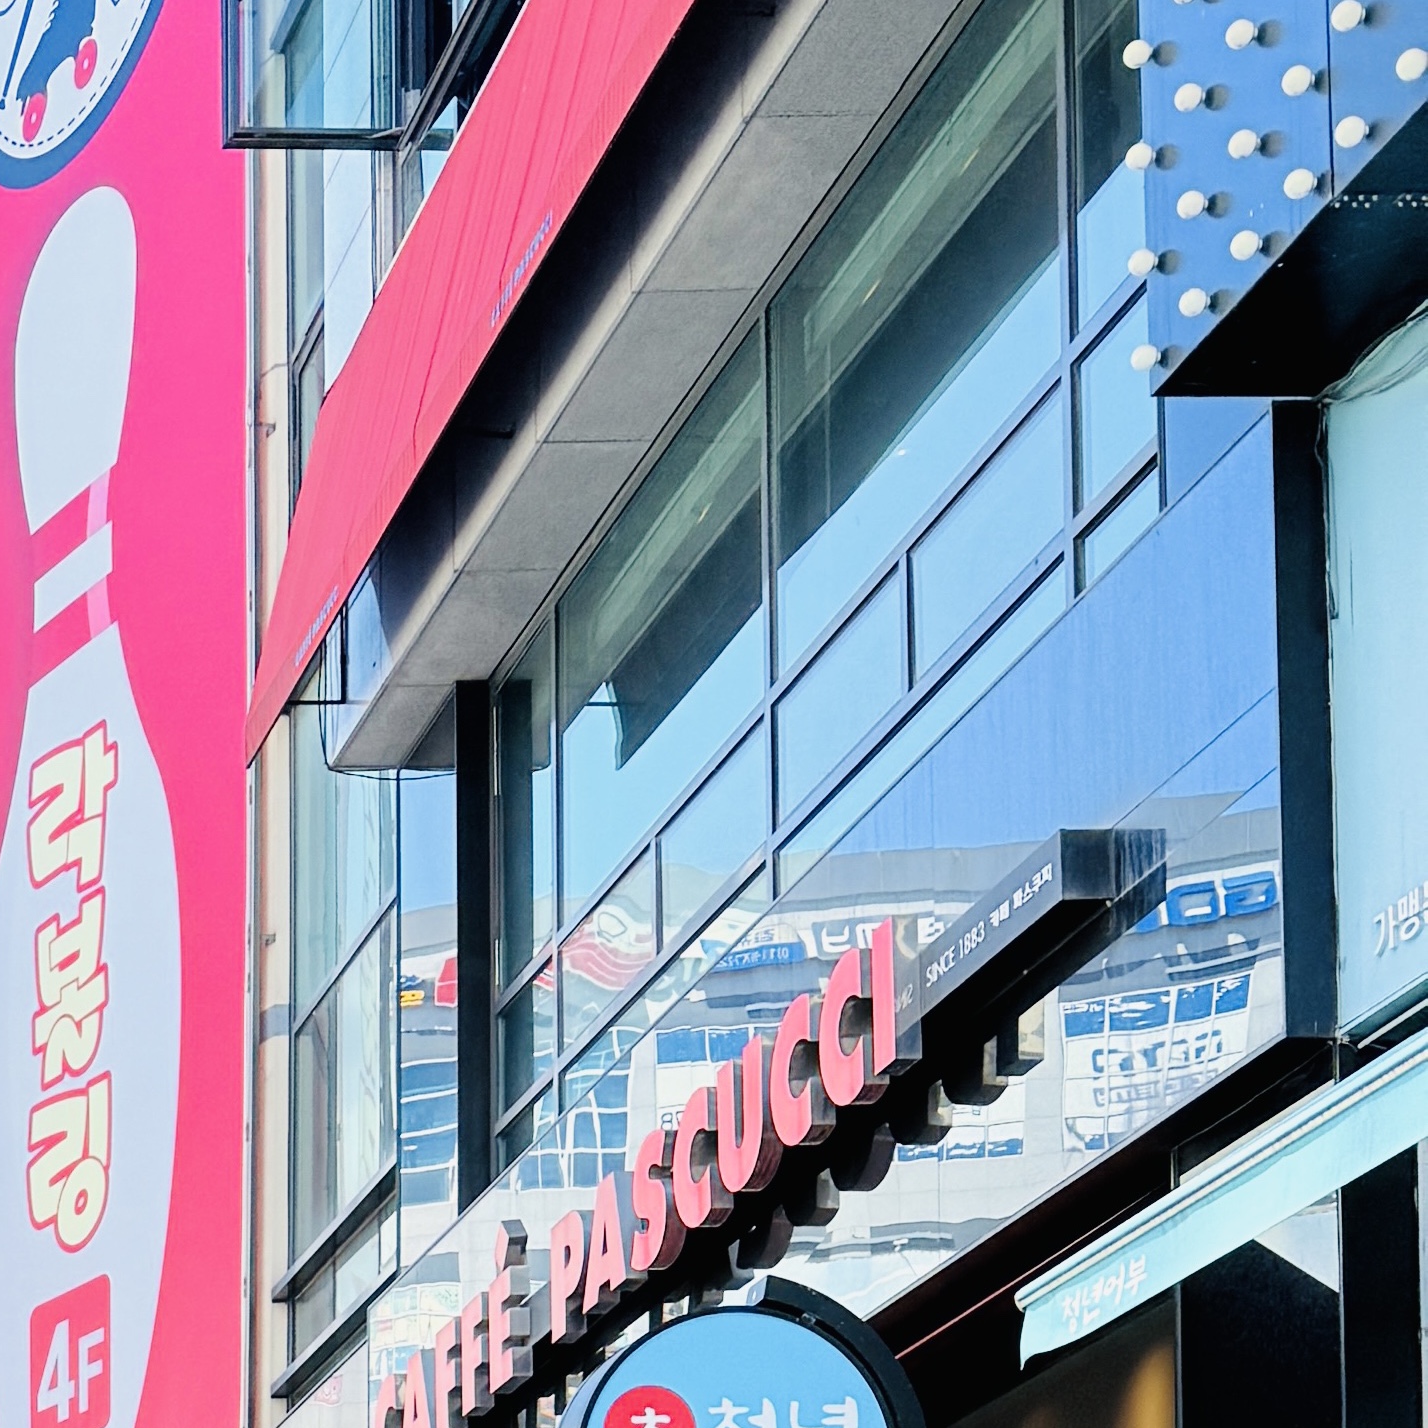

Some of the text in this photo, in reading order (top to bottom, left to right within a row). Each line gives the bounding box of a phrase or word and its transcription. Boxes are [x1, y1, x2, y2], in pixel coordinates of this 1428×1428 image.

[27, 719, 117, 1254] 락볼링
[925, 944, 956, 988] SINCE
[958, 921, 986, 959] 1883
[550, 917, 896, 1344] PASCUCCI
[1060, 1258, 1150, 1338] 청년어부
[35, 1319, 105, 1426] 4F
